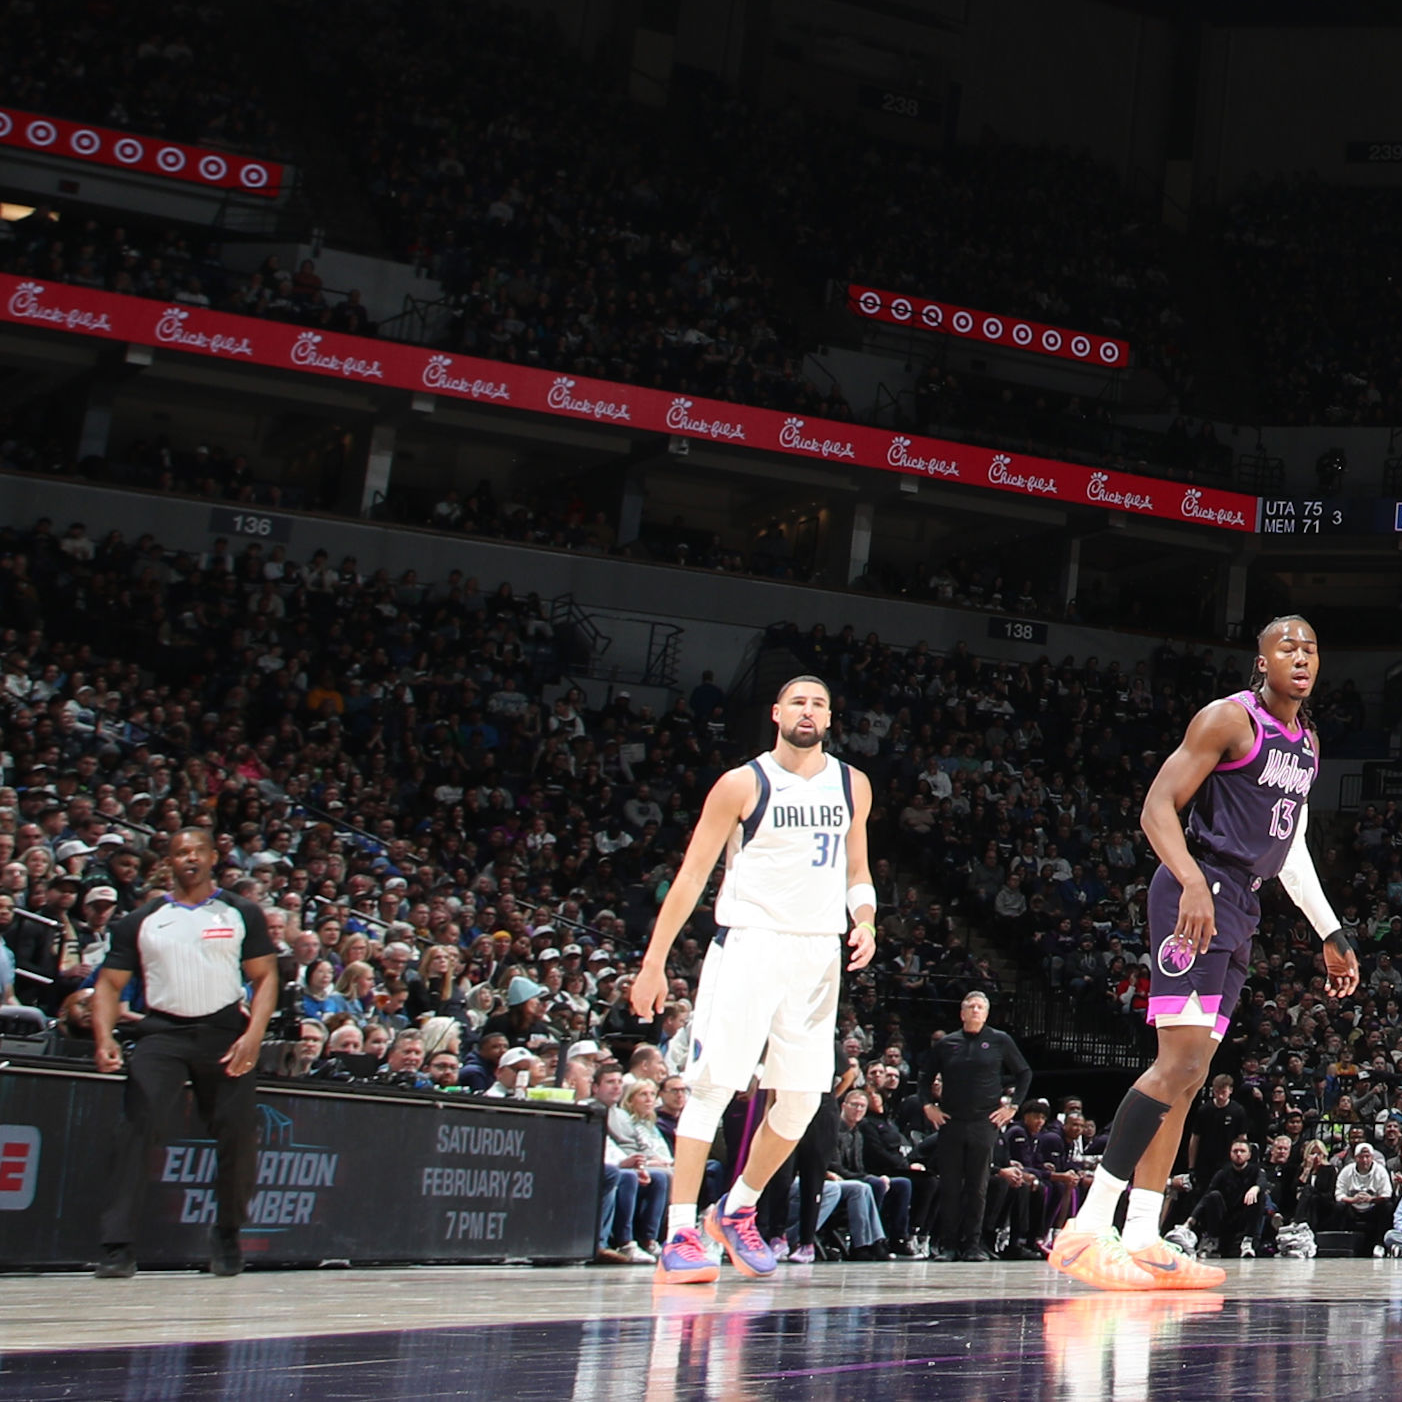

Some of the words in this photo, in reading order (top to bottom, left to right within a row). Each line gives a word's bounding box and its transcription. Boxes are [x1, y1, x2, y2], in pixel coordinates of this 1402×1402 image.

[881, 93, 919, 117] 238
[8, 282, 111, 332] Chick-fil-A
[155, 307, 253, 356] Chick-fil-A
[291, 331, 383, 378] Chick-fil-A
[422, 354, 510, 400] Chick-fil-A
[547, 376, 631, 421] Chick-fil-A
[666, 397, 746, 440] Chick-fil-A
[779, 416, 855, 458] Chick-fil-A
[886, 435, 960, 477] Chick-fil-A
[987, 454, 1058, 494] Chick-fil-A
[1086, 471, 1153, 510] Chick-fil-A
[1180, 488, 1245, 526] Chick-fil-A
[1265, 501, 1296, 516] UTA
[1303, 501, 1323, 516] 75
[232, 515, 272, 536] 136
[1264, 519, 1296, 534] MEM
[1302, 518, 1321, 534] 71
[1331, 509, 1344, 526] 3
[1004, 622, 1033, 639] 138
[1257, 748, 1315, 797] Wolves
[773, 805, 844, 829] DALLAS
[1268, 798, 1298, 840] 13
[811, 832, 842, 868] 31
[436, 1124, 526, 1162] SATURDAY,
[161, 1146, 339, 1187] ELIATION
[421, 1167, 511, 1198] FEBRUARY
[512, 1170, 534, 1199] 28
[180, 1188, 317, 1224] CHMBER
[445, 1211, 457, 1240] 7
[458, 1211, 484, 1240] PM
[485, 1211, 508, 1240] ET
